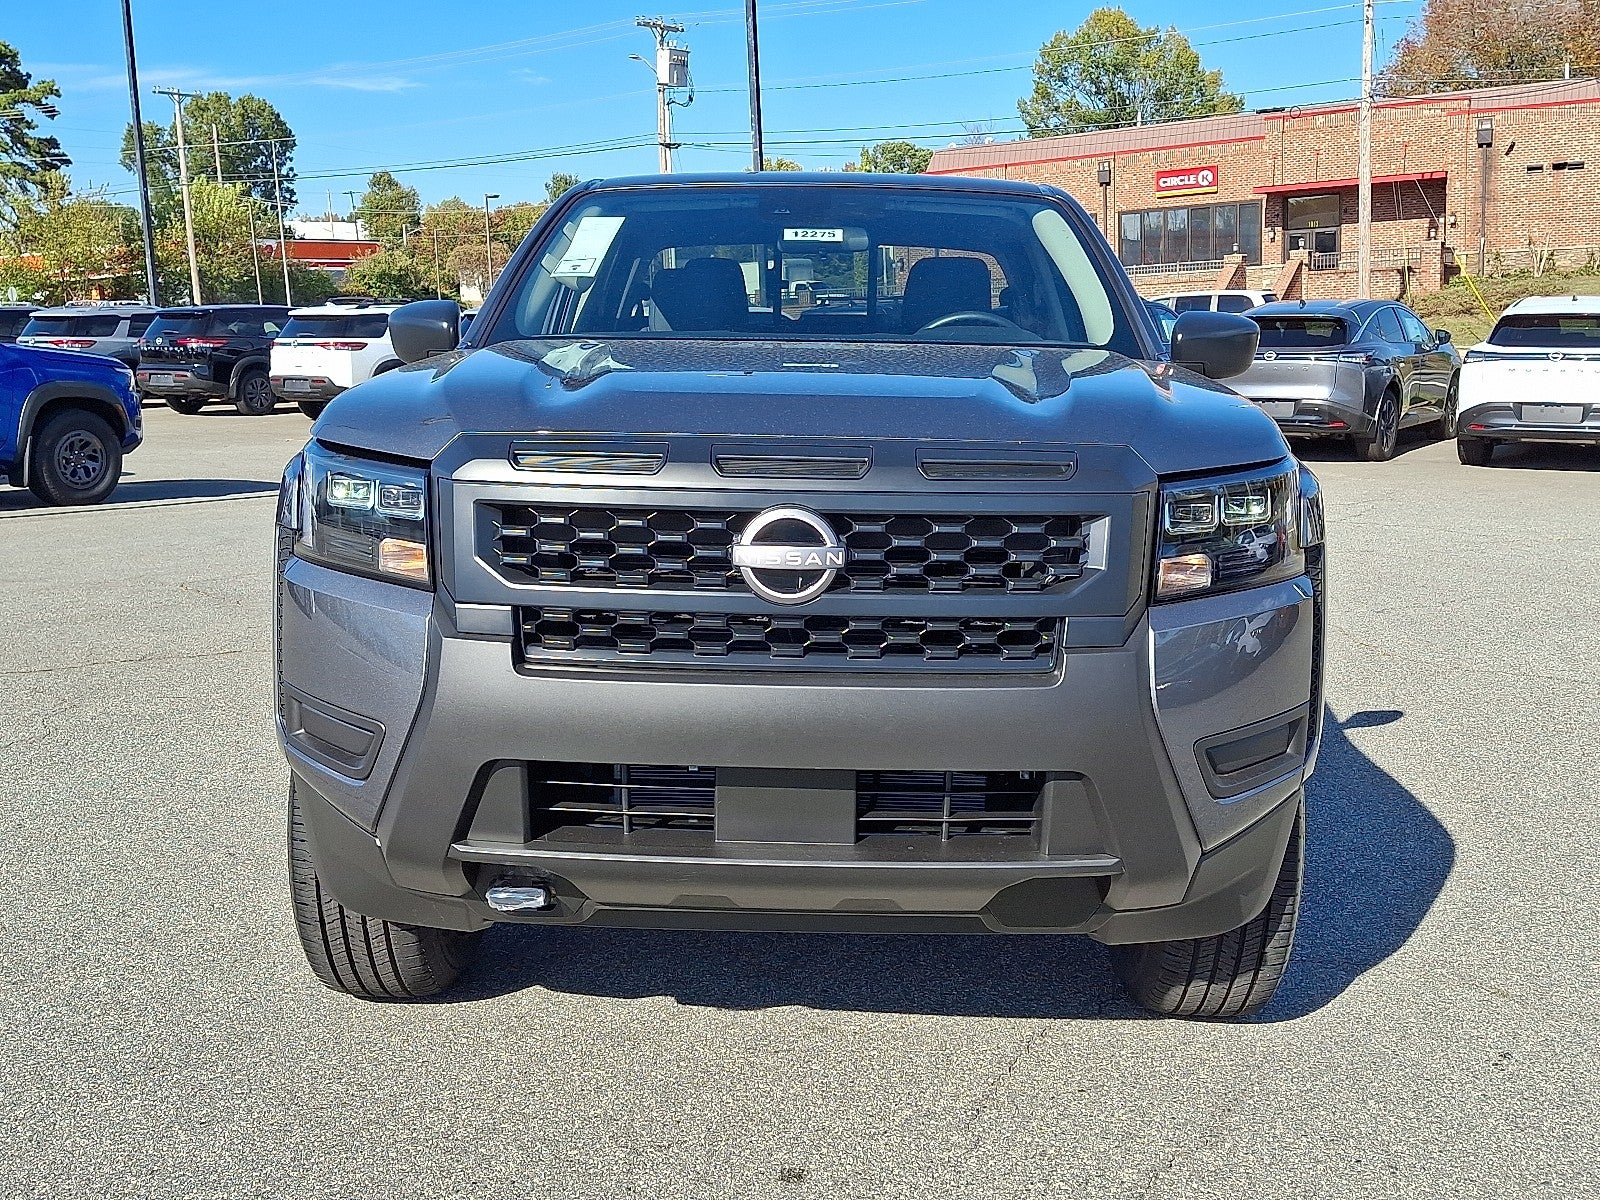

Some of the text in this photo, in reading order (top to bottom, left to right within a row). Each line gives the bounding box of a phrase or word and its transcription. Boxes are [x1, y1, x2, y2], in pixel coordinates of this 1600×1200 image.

[1159, 174, 1197, 188] CIRCLE
[792, 230, 836, 238] 12275
[735, 548, 843, 567] NISSAN
